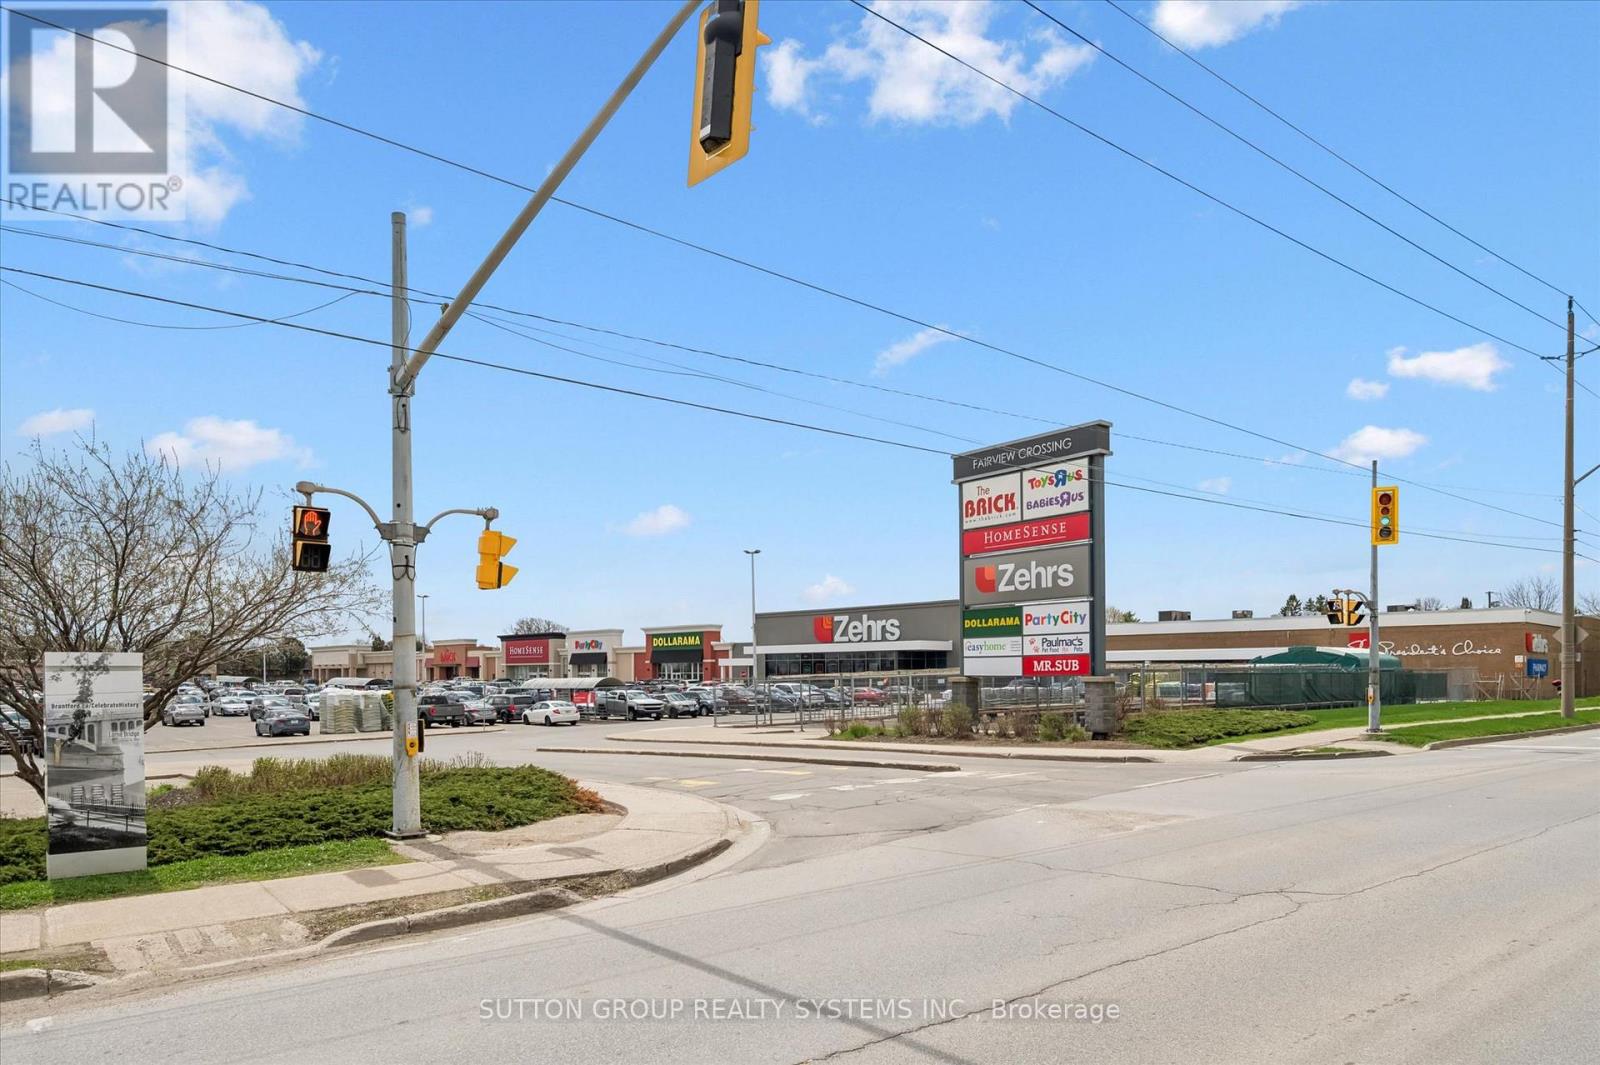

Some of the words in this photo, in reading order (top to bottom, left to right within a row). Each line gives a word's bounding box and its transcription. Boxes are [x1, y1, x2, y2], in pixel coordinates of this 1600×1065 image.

[972, 451, 1016, 470] FAIRVIEW
[1018, 437, 1072, 460] CROSSING
[977, 486, 991, 497] The
[964, 492, 1016, 518] BRICK
[998, 560, 1074, 593] Zehrs
[833, 614, 901, 643] Zehrs
[964, 616, 1020, 628] DOLLARAMA
[653, 635, 700, 647] DOLLARAMA
[1041, 636, 1083, 648] Paulmac's
[1378, 641, 1447, 656] President's
[1452, 639, 1502, 656] Choice
